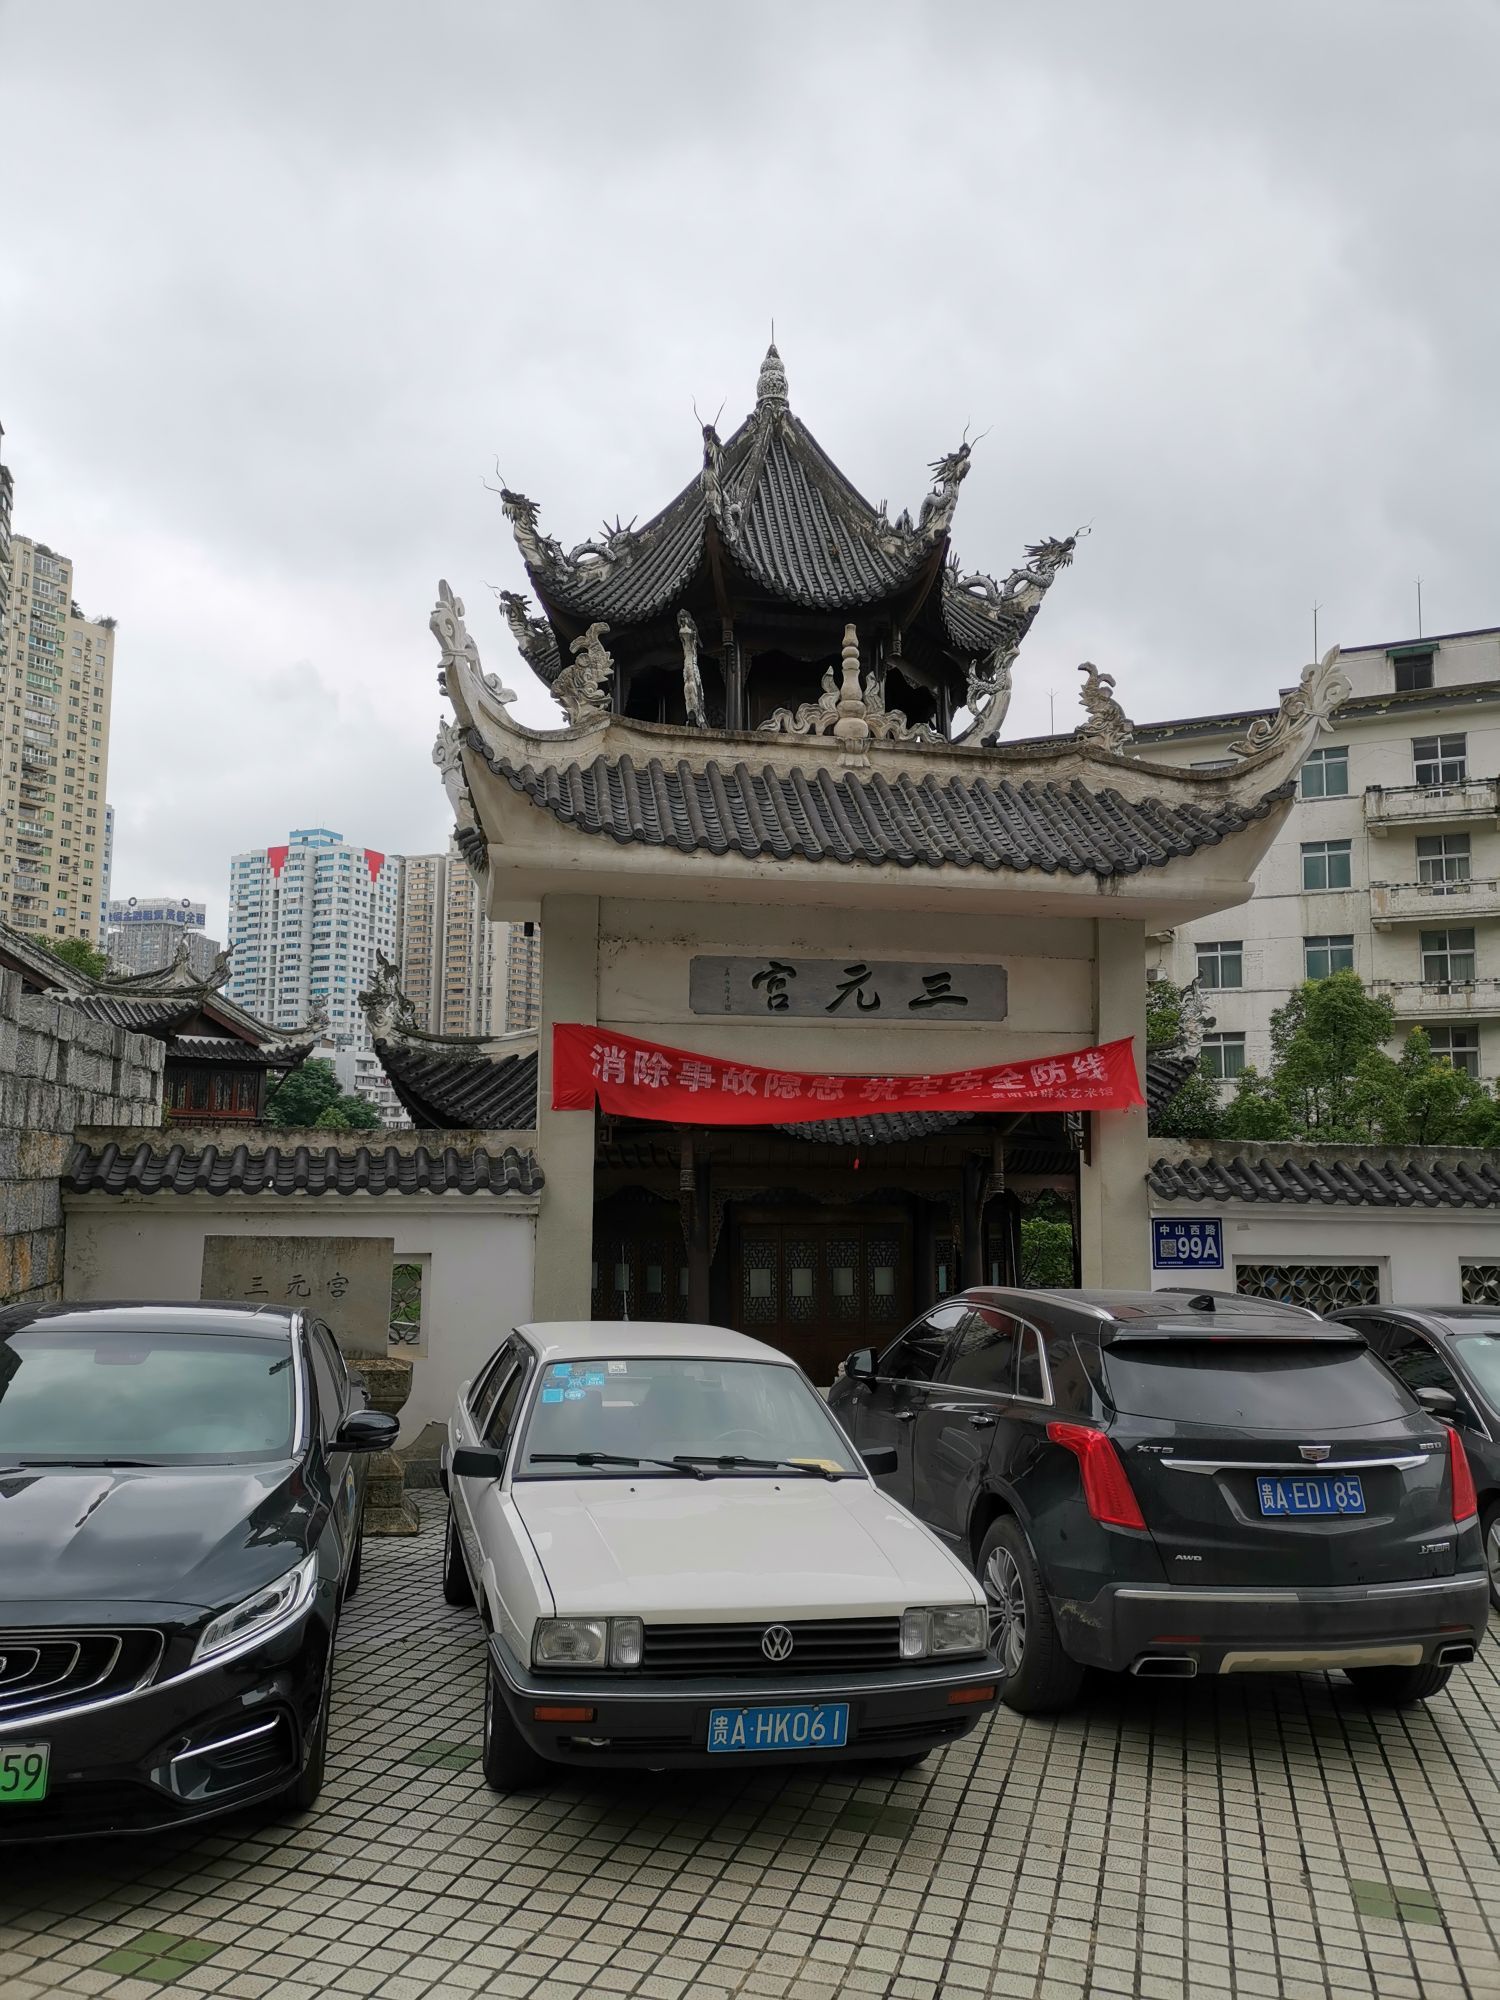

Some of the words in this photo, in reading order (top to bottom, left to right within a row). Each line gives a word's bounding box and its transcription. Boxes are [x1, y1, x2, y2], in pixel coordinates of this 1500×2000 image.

[589, 1043, 845, 1101] 消除事故隐患
[859, 1052, 1109, 1102] 筑牢安全防线
[1160, 1224, 1216, 1236] 中山西路
[1177, 1237, 1219, 1259] 99A
[244, 1272, 349, 1298] 三元宫
[1137, 1445, 1174, 1454] XT5
[712, 1710, 840, 1745] 贵A·HK061
